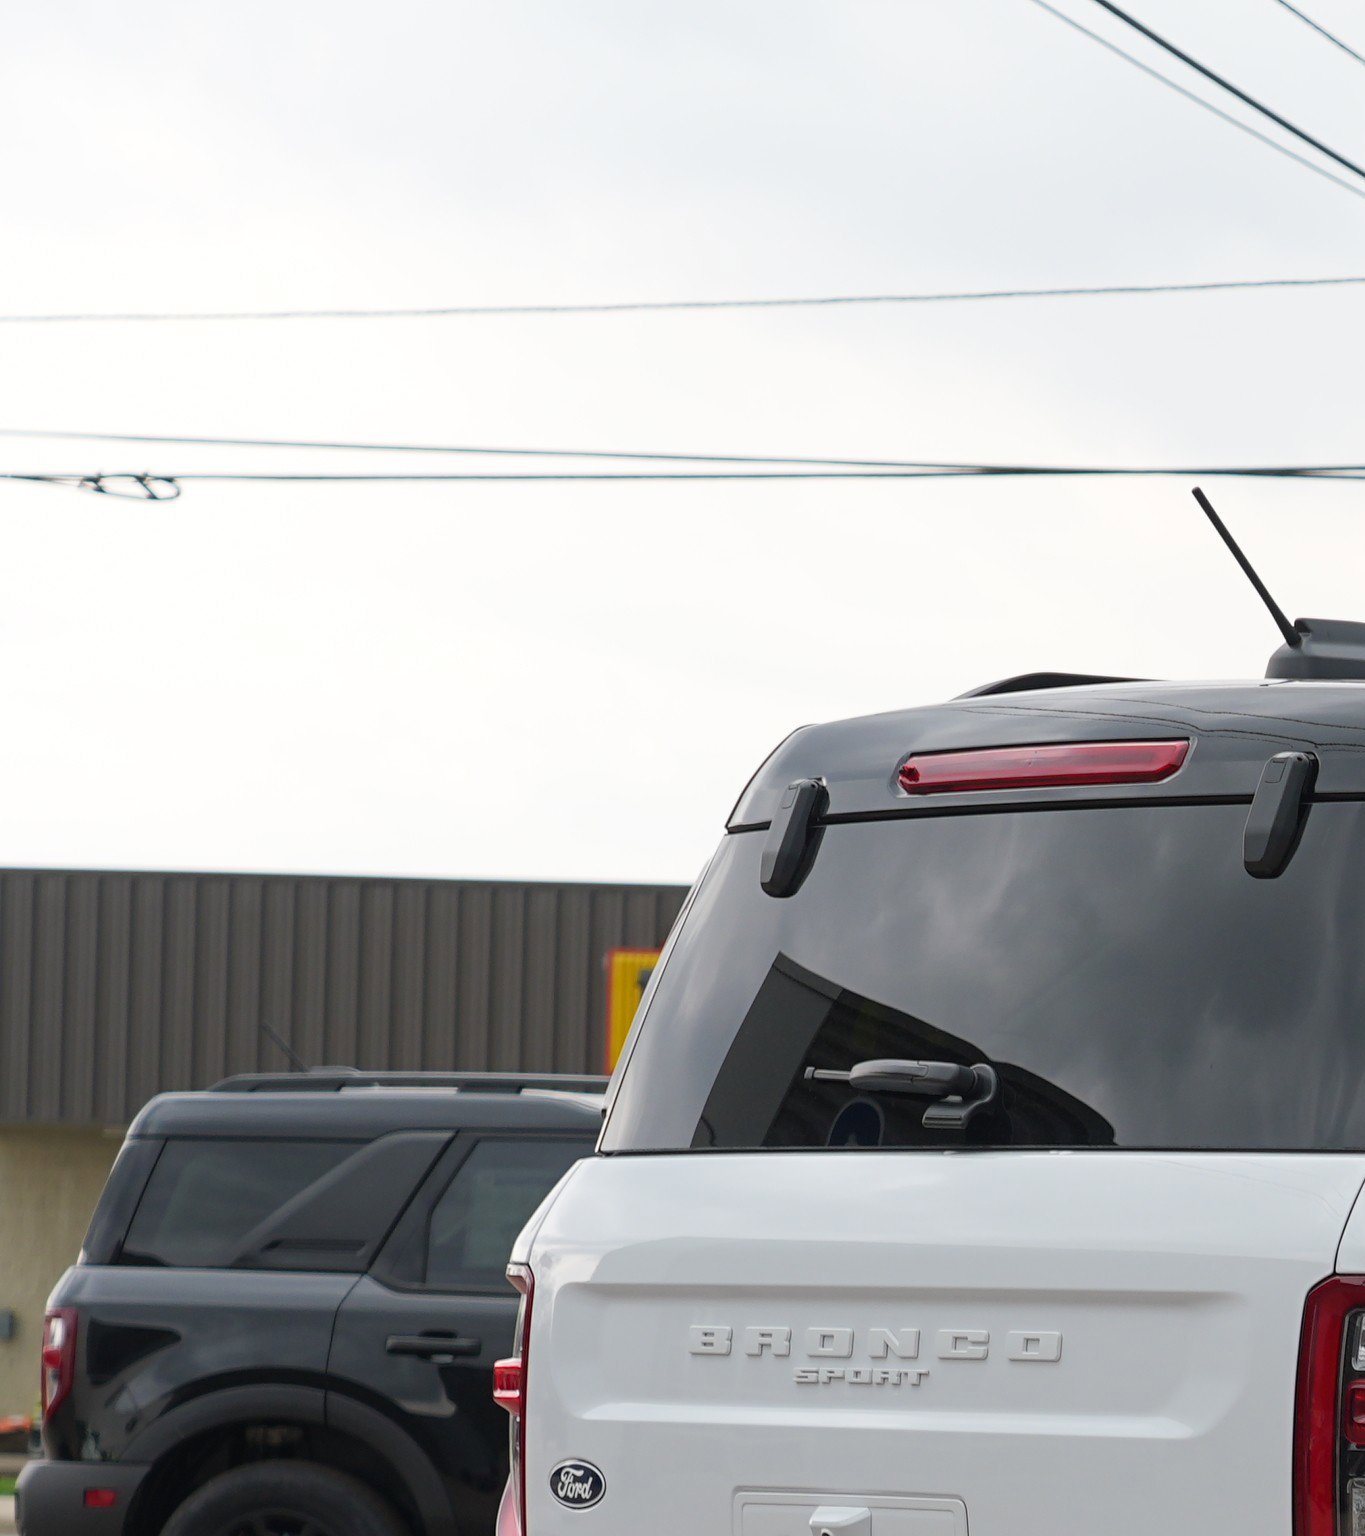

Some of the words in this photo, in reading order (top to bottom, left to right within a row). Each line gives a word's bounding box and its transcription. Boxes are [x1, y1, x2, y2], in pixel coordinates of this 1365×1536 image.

[688, 1325, 1063, 1362] BRONCO
[793, 1366, 929, 1386] SPORT
[557, 1467, 593, 1499] Ford
